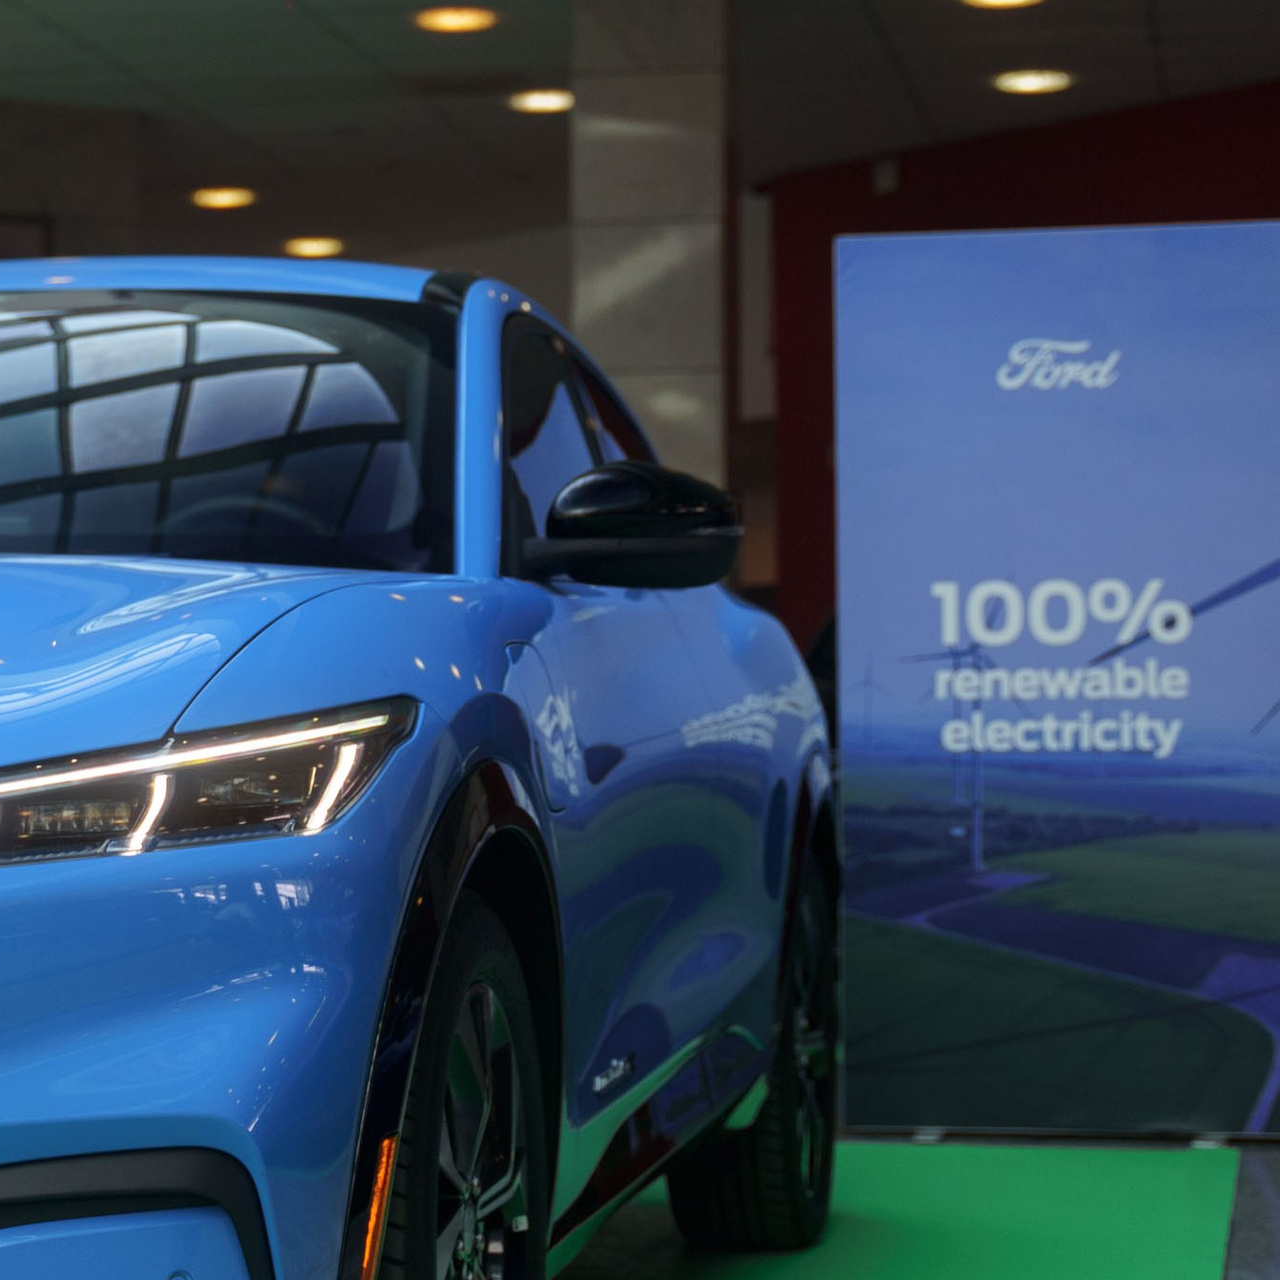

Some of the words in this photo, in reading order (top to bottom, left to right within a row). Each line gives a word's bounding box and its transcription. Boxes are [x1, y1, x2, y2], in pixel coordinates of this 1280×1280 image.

[996, 338, 1120, 390] Ford
[930, 578, 1193, 647] 100%
[934, 659, 1190, 701] renewable
[941, 710, 1183, 759] electricity
